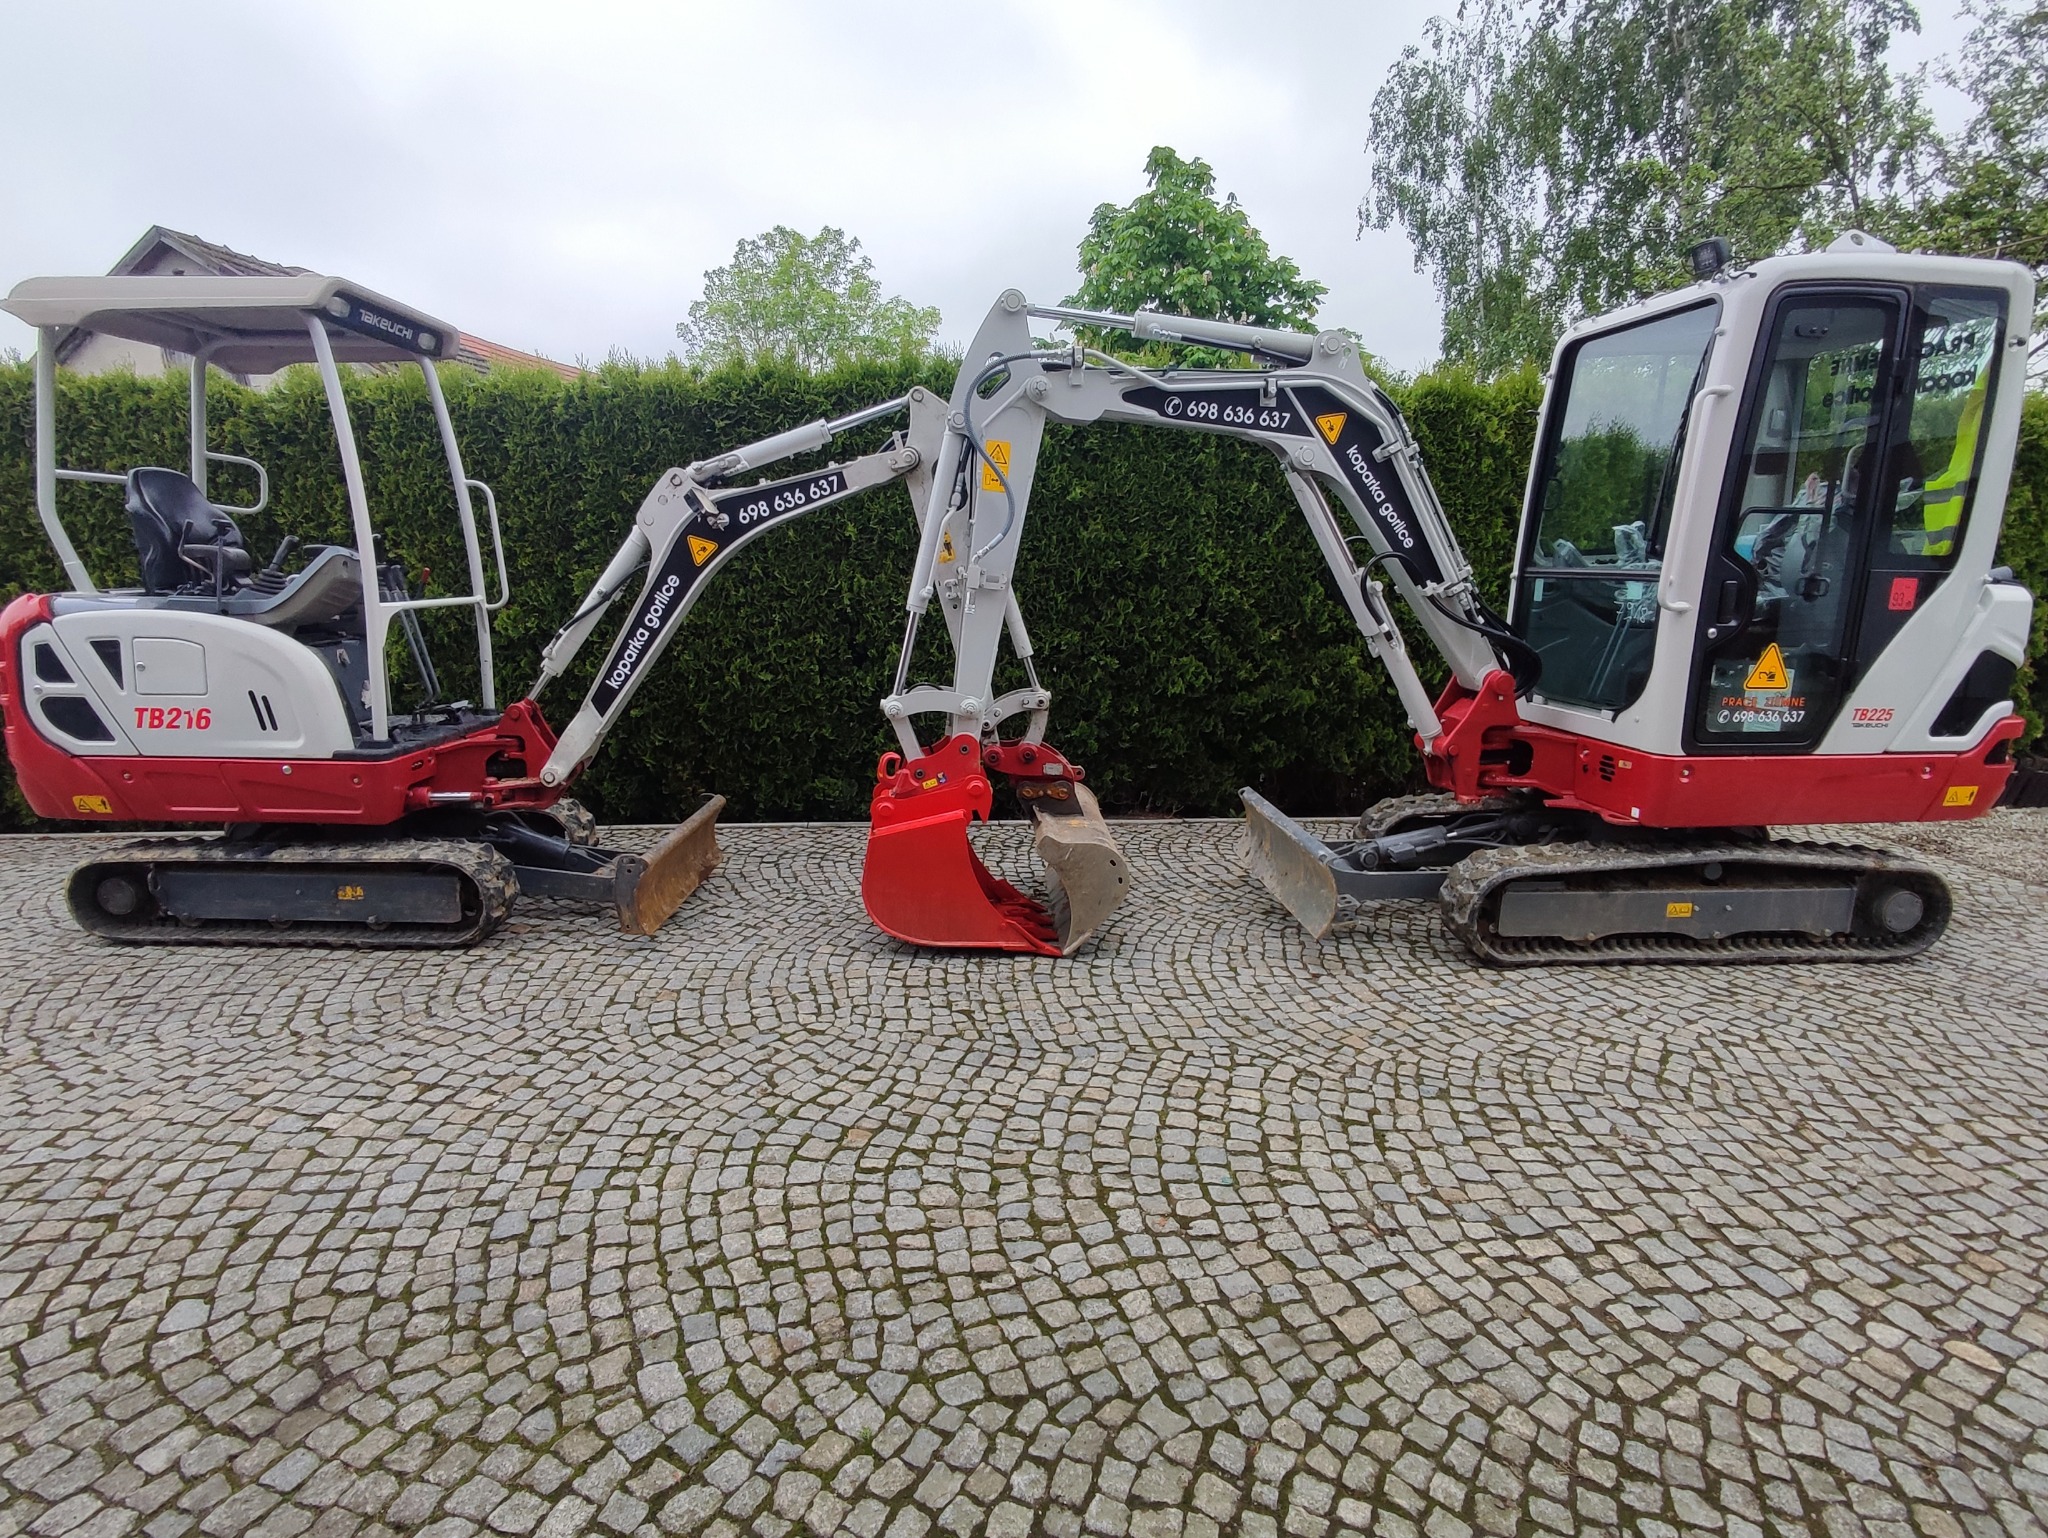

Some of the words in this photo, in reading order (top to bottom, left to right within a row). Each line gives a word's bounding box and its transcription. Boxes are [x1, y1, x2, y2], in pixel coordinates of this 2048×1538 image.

[1186, 400, 1218, 419] 698
[1223, 405, 1255, 424] 636
[1259, 410, 1291, 429] 637
[739, 500, 770, 524] 698
[774, 488, 806, 512] 636
[809, 475, 838, 500] 637
[1346, 444, 1386, 503] koparka
[1379, 502, 1414, 548] gorlice
[605, 627, 650, 689] koparka
[644, 574, 680, 629] gorlice
[134, 707, 212, 730] TB216
[1732, 711, 1755, 723] 698
[1757, 711, 1780, 723] 636
[1782, 711, 1806, 723] 637
[1852, 708, 1895, 721] TB225
